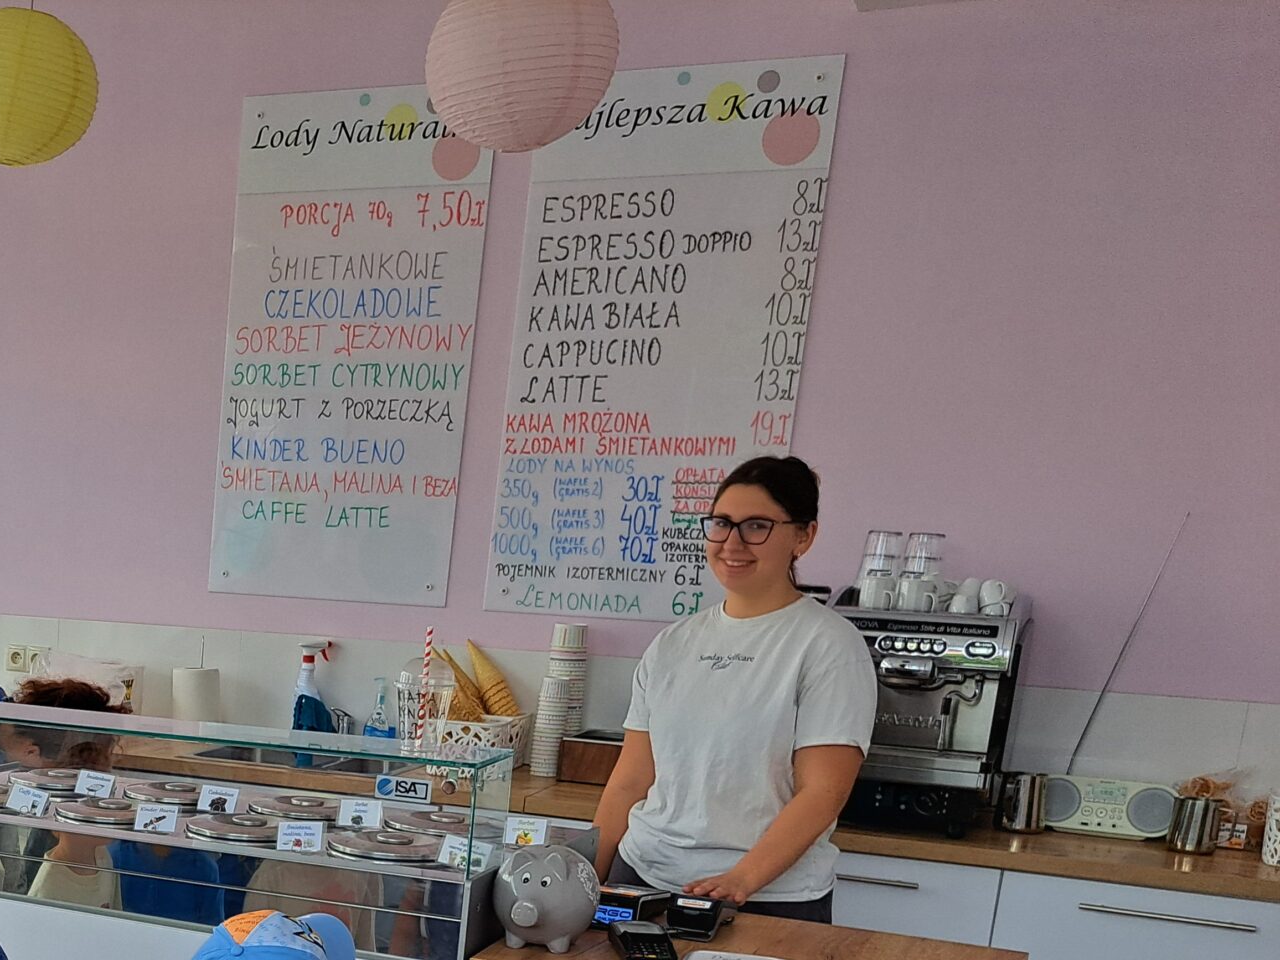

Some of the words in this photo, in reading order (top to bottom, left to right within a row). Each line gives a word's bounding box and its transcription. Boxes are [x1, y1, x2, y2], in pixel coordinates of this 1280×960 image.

[574, 97, 708, 141] ajlepsza
[718, 92, 829, 122] Kawa
[251, 119, 320, 155] Lody
[328, 119, 457, 147] Natura
[280, 202, 355, 237] PORCJA
[368, 200, 393, 227] 70g
[542, 188, 675, 223] ESPRESSO
[537, 229, 675, 263] ESPRESSO
[683, 231, 752, 255] DOPPIO
[269, 245, 448, 283] ŚMIETANKOWE
[533, 263, 686, 297] AMERICANO
[265, 286, 443, 319] CZEKOLADOWE
[528, 303, 596, 332] KAWA
[603, 301, 680, 330] BIAŁA
[235, 324, 329, 355] SORBET
[334, 321, 473, 357] JEŻYNOWY
[523, 336, 662, 369] CAPPUCINO
[231, 363, 321, 387] SORBET
[331, 362, 465, 391] CYTRYNOWY
[520, 375, 608, 404] LATTE
[227, 396, 306, 427] JOGURT
[318, 399, 332, 419] Z
[342, 397, 455, 432] PORZECZKĄ
[506, 412, 554, 433] KAWA
[231, 436, 309, 462] KINDER
[321, 437, 405, 465] BUENO
[506, 458, 547, 474] LODY
[554, 459, 575, 473] NA
[582, 459, 634, 474] WYNOS
[333, 471, 403, 494] MALINA
[423, 475, 458, 498] BEZA
[242, 500, 308, 524] CAFFE
[325, 505, 391, 528] LATTE
[662, 542, 706, 552] OPAKOW
[496, 562, 556, 582] POJEMNIK
[567, 566, 667, 584] IZOTERMICZNY
[516, 584, 642, 614] LEMONIADA
[395, 779, 418, 796] ISA
[597, 907, 632, 919] RGO
